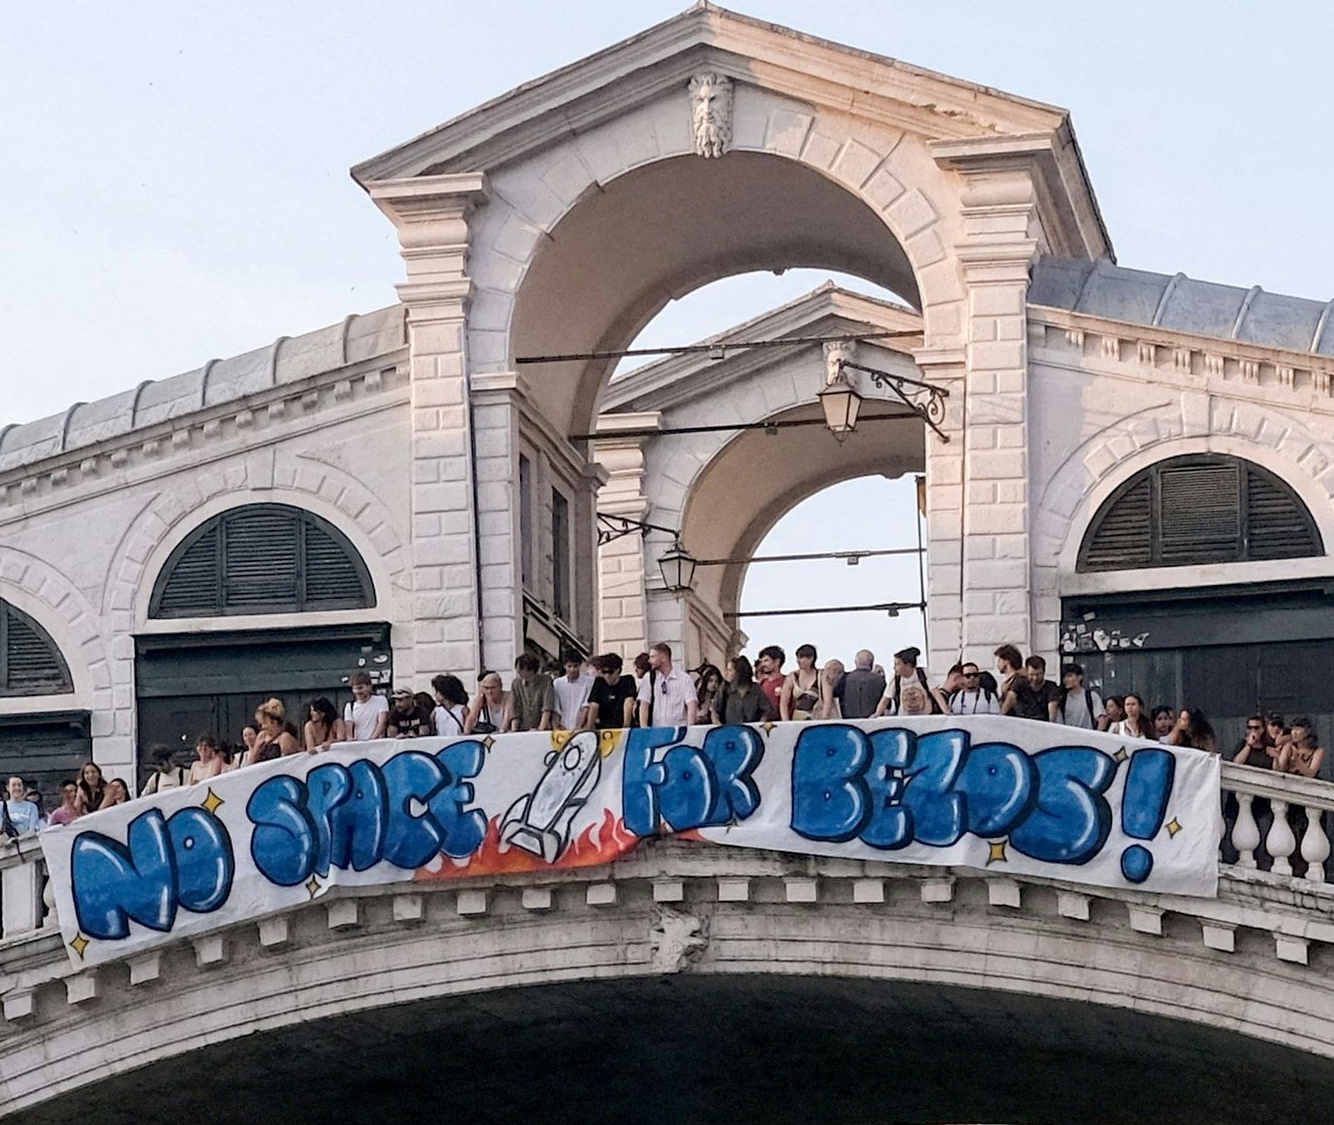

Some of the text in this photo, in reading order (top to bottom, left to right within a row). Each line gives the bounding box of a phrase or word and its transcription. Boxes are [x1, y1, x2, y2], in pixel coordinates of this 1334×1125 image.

[71, 722, 1176, 940] NO SPACE FOR BEZOS!
